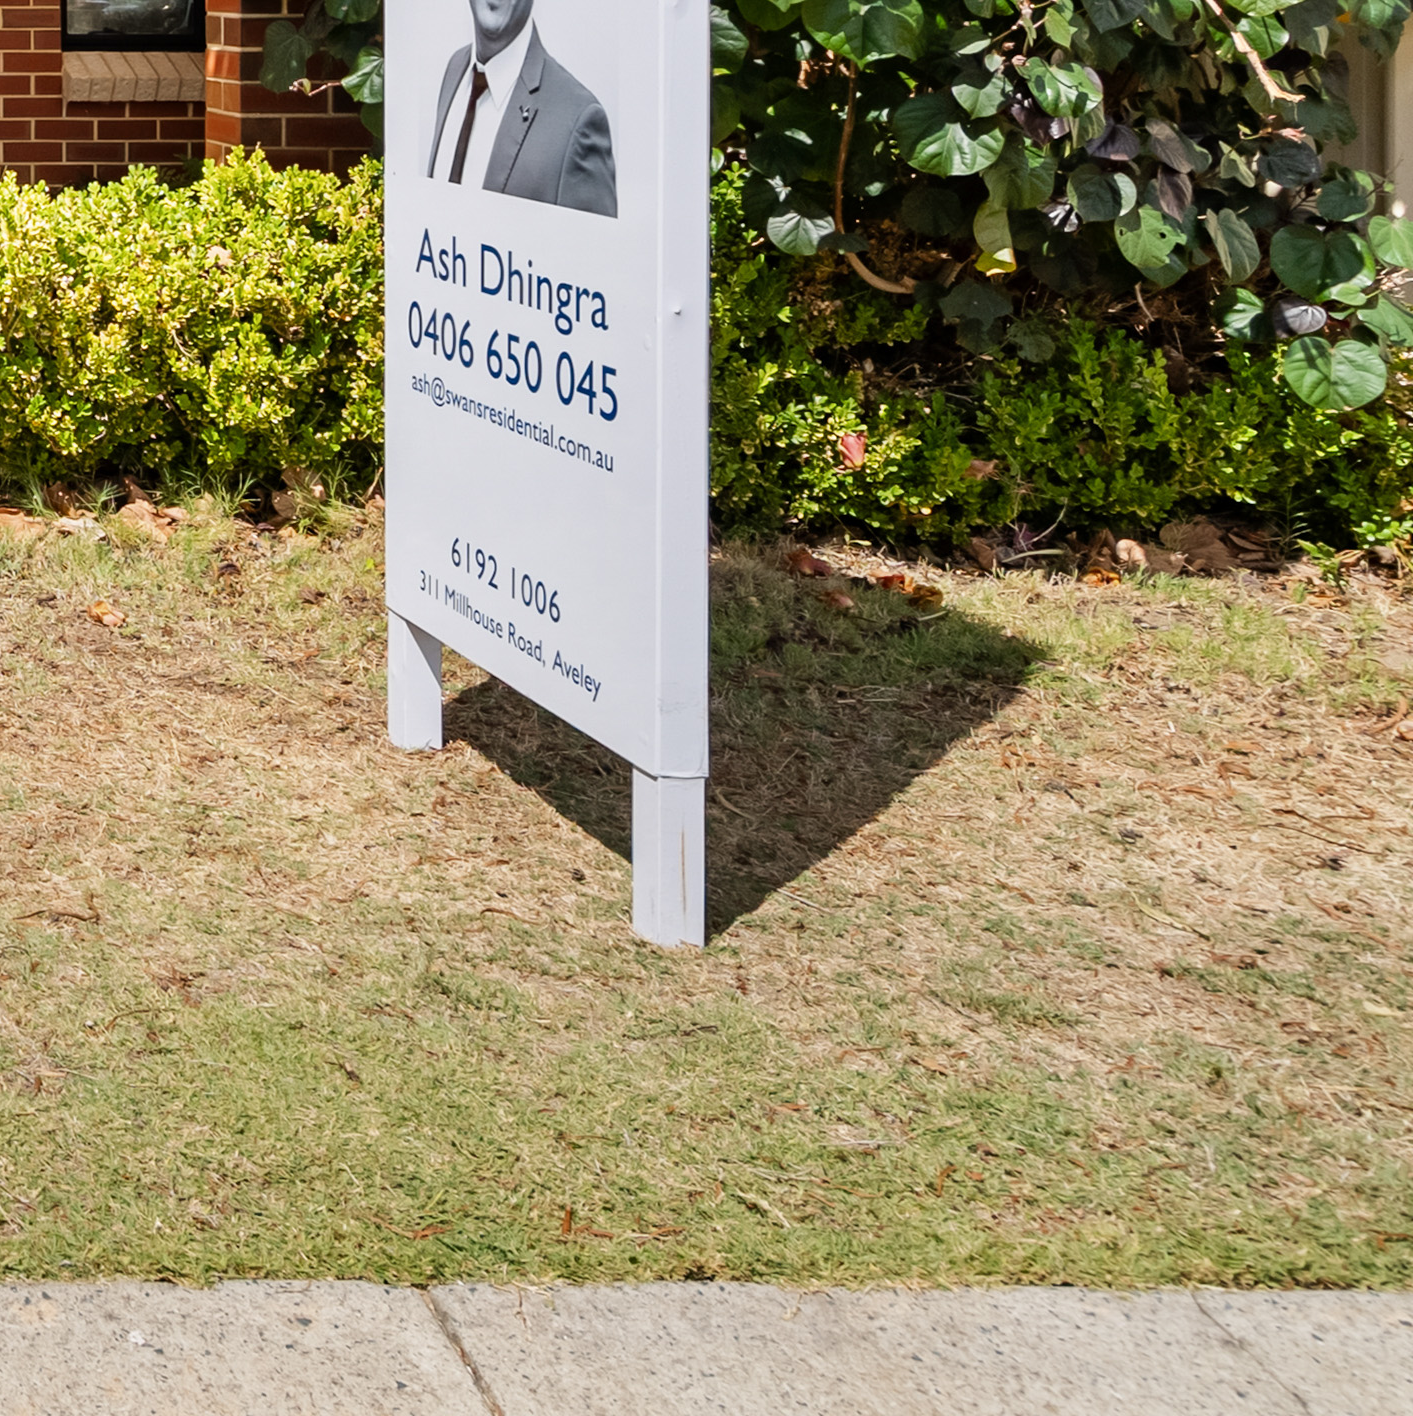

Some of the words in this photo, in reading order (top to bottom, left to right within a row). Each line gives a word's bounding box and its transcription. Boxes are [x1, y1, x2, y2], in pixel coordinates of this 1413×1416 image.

[415, 227, 468, 288] Ash
[480, 243, 609, 336] Dhingra
[408, 300, 474, 369] 0406
[486, 328, 543, 394] 650
[556, 351, 619, 423] 045
[411, 372, 615, 474] ash@swansresidential.com.au
[450, 537, 499, 590] 6192
[511, 567, 562, 624] 1006
[419, 570, 441, 602] 311
[444, 585, 504, 640] Millhouse
[508, 627, 547, 669] Road,
[552, 649, 603, 703] Aveley
